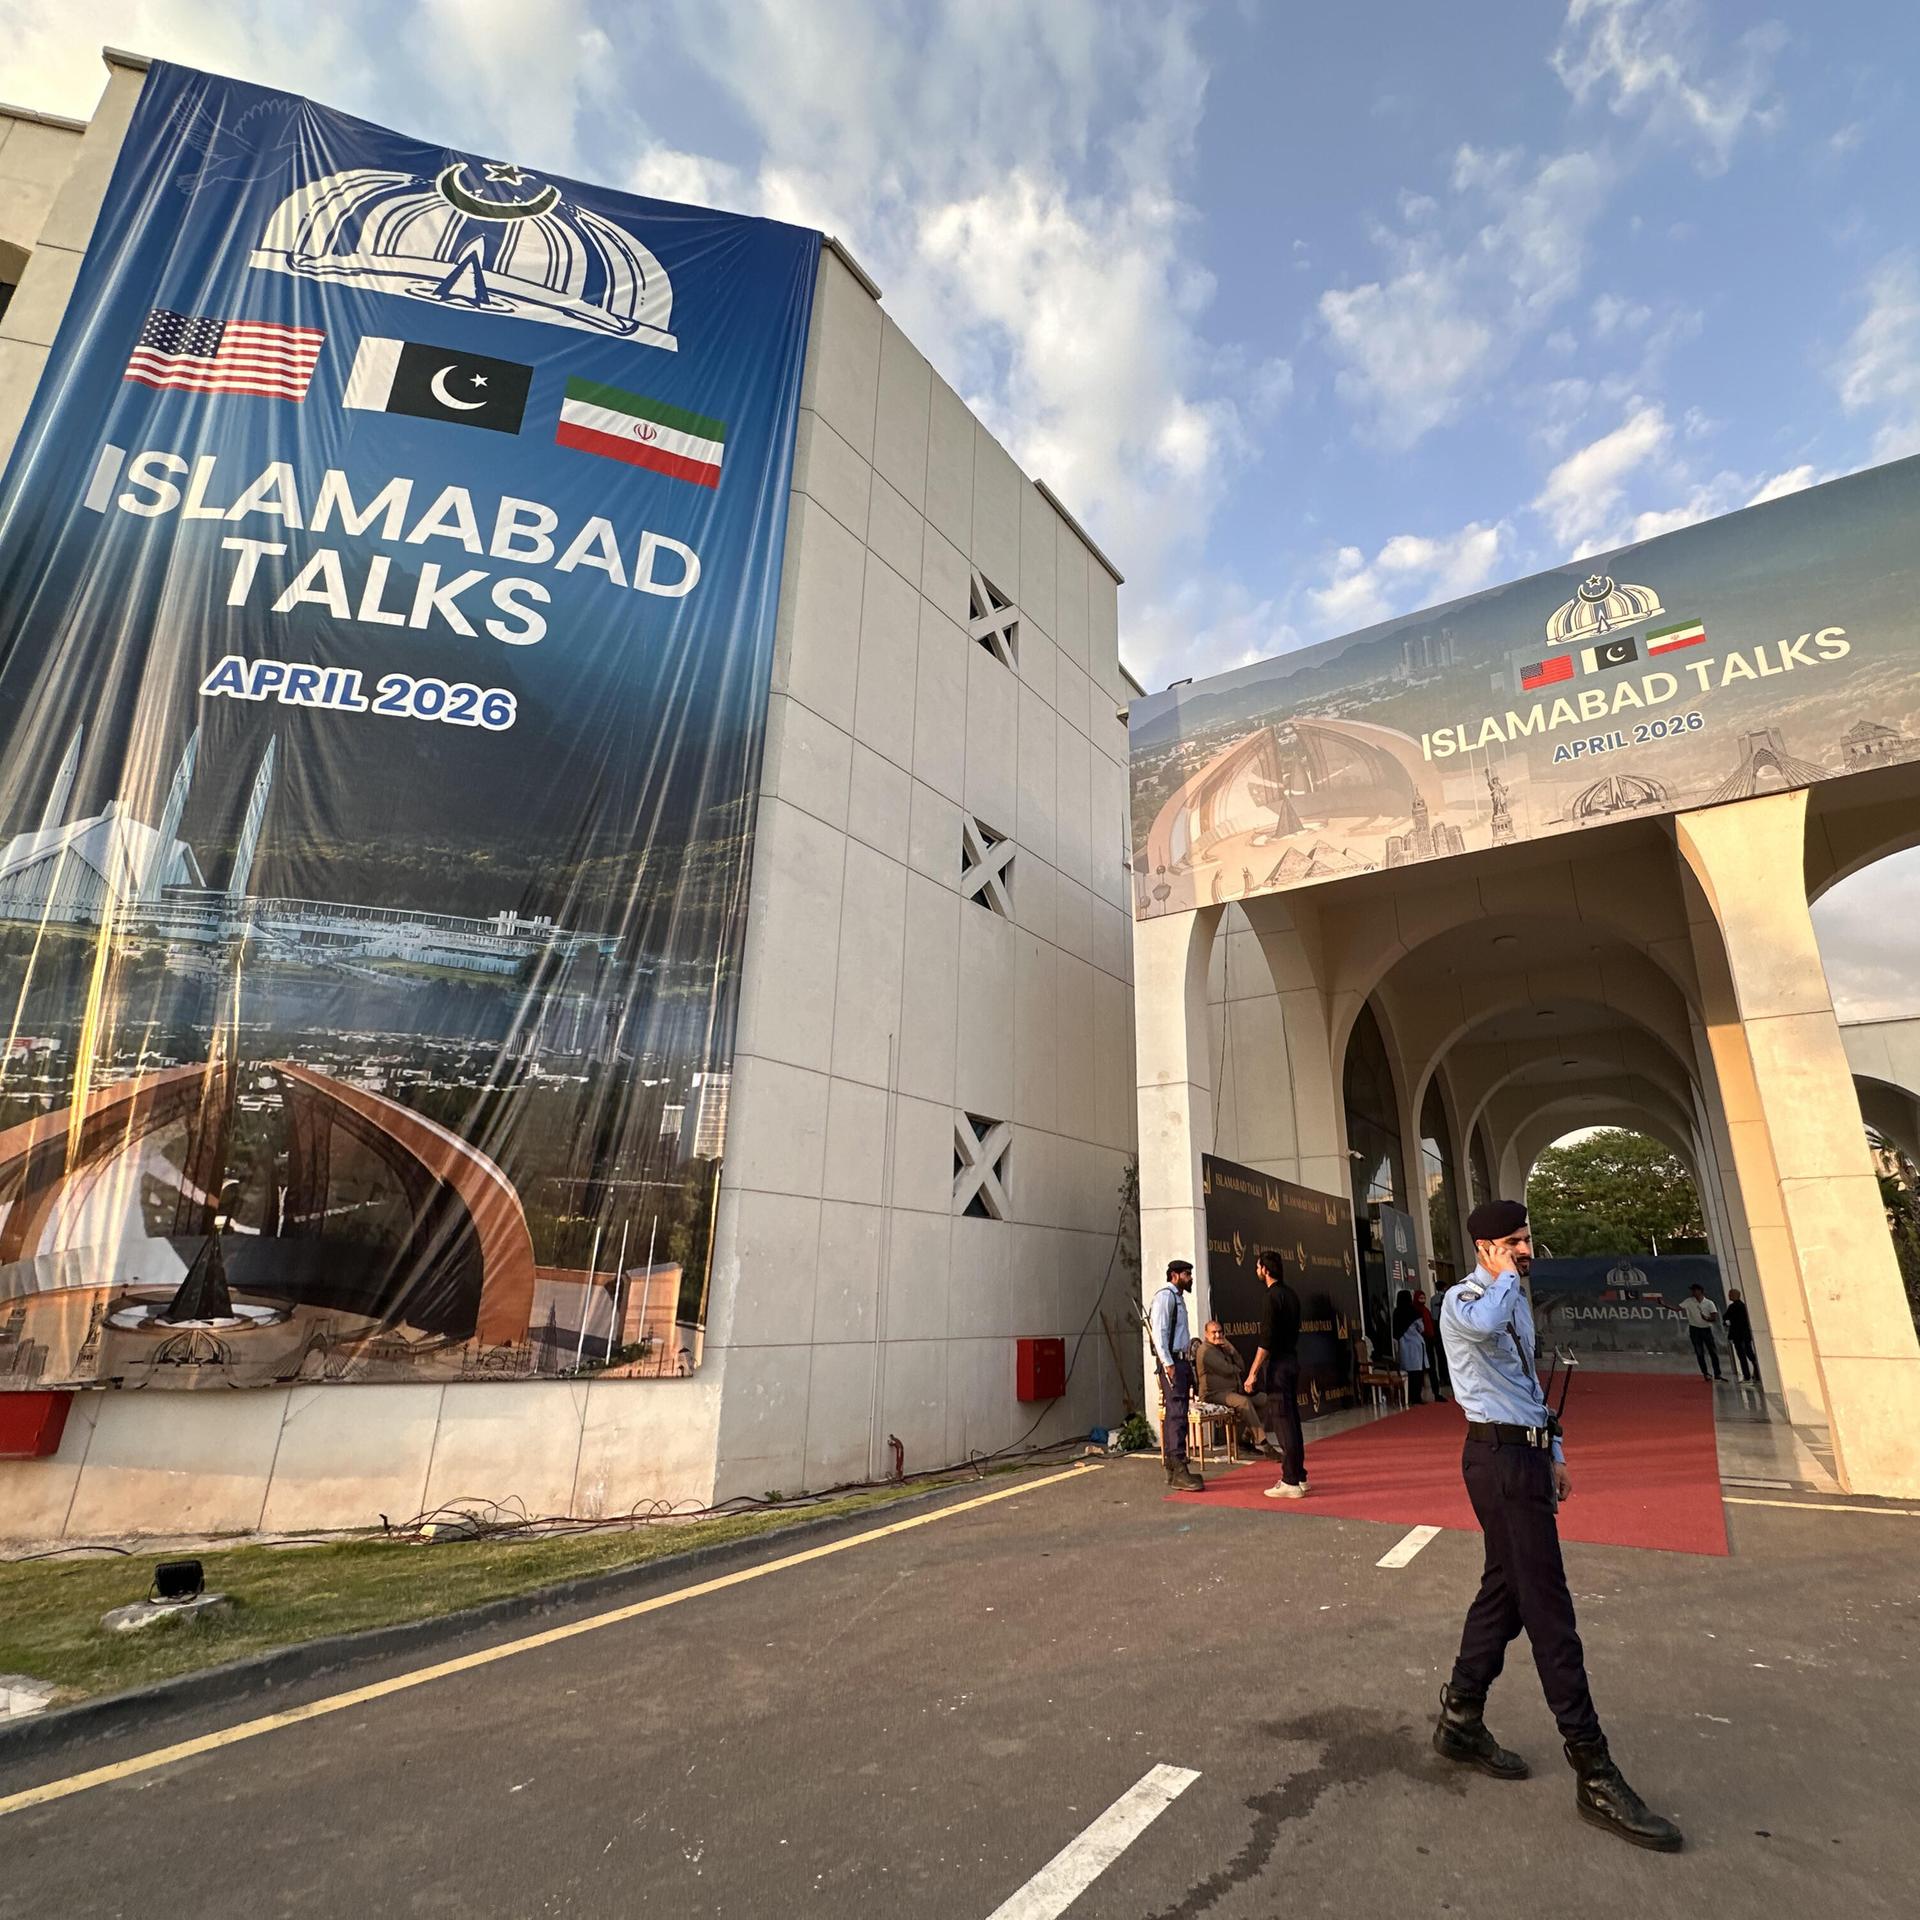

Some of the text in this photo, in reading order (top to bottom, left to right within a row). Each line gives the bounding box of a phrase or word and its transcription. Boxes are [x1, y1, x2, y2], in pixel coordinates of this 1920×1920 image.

[83, 444, 702, 598] ISLAMABAD
[221, 537, 551, 646] TALKS
[199, 655, 518, 732] APRIL 2026
[1420, 626, 1851, 761] ISLAMABAD TALKS
[1552, 711, 1705, 764] APRIL 2026
[1561, 1306, 1686, 1320] ISLAMABAD TAL
